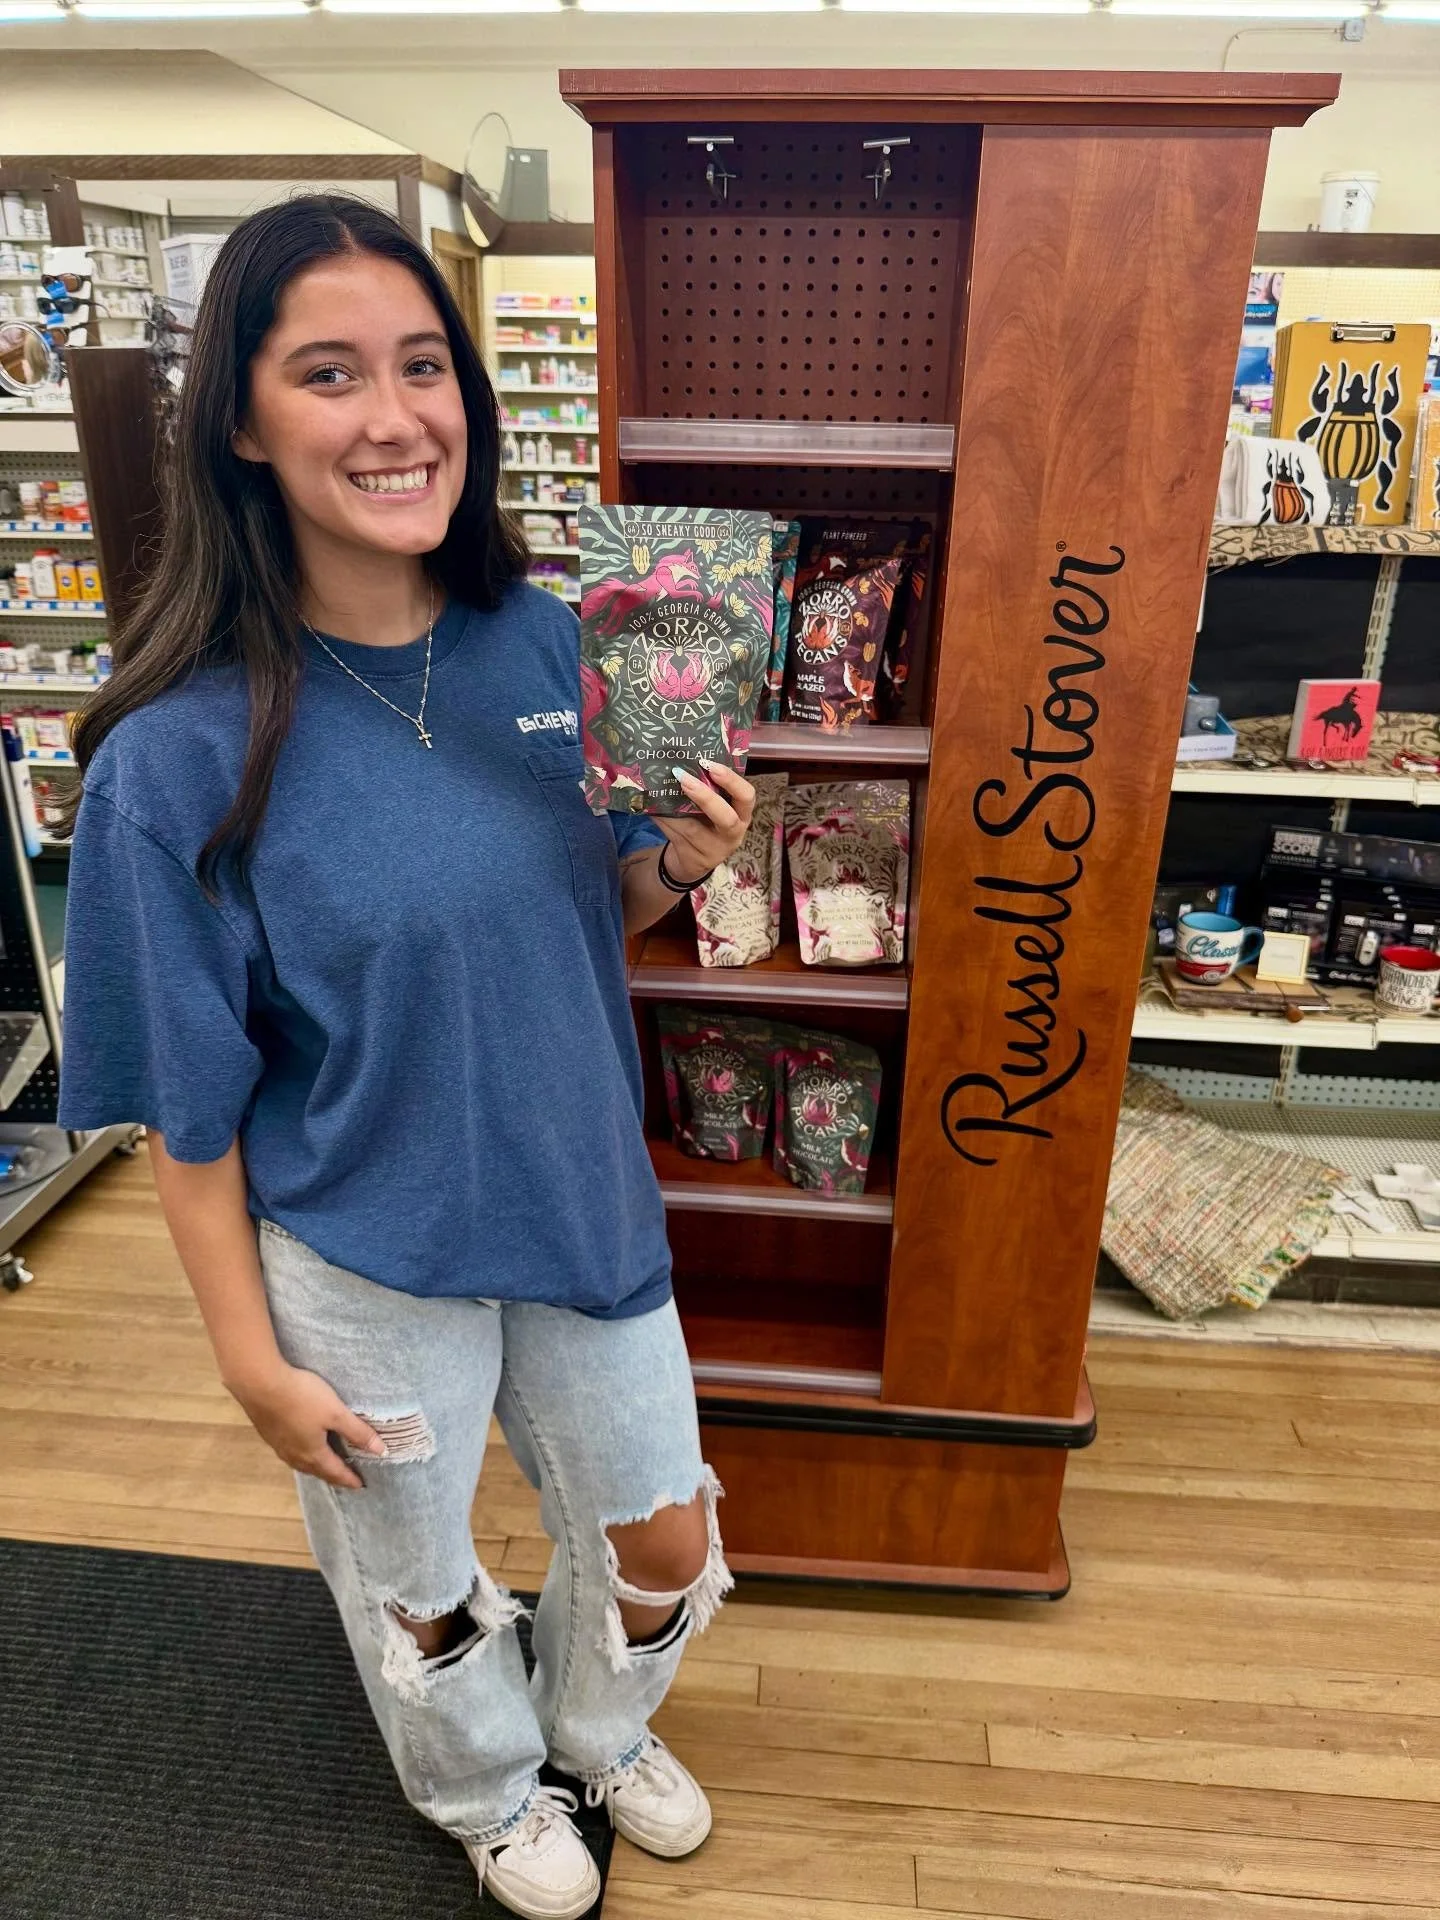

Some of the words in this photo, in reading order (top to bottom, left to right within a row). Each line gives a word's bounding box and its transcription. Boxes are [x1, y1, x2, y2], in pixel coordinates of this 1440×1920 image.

[641, 523, 653, 536] SO
[655, 524, 690, 537] SNEAKY
[693, 526, 716, 538] GOOD
[628, 611, 655, 631] 100%
[657, 602, 700, 618] GEORGIA
[703, 608, 732, 636] GROWN
[798, 590, 851, 619] ZORRO
[634, 617, 723, 655] ZORRO
[794, 631, 848, 664] PECANS
[632, 660, 643, 669] GA
[796, 673, 825, 685] MAPLE
[631, 676, 724, 721] PECANS
[972, 544, 1126, 852] Stover
[635, 749, 715, 760] CHOCOLATE
[661, 736, 696, 747] MILK
[821, 843, 875, 864] ZORRO
[939, 853, 1088, 1167] Russell
[798, 1076, 848, 1105] ZORRO
[791, 1106, 847, 1138] PECANS
[800, 1141, 822, 1154] MILK
